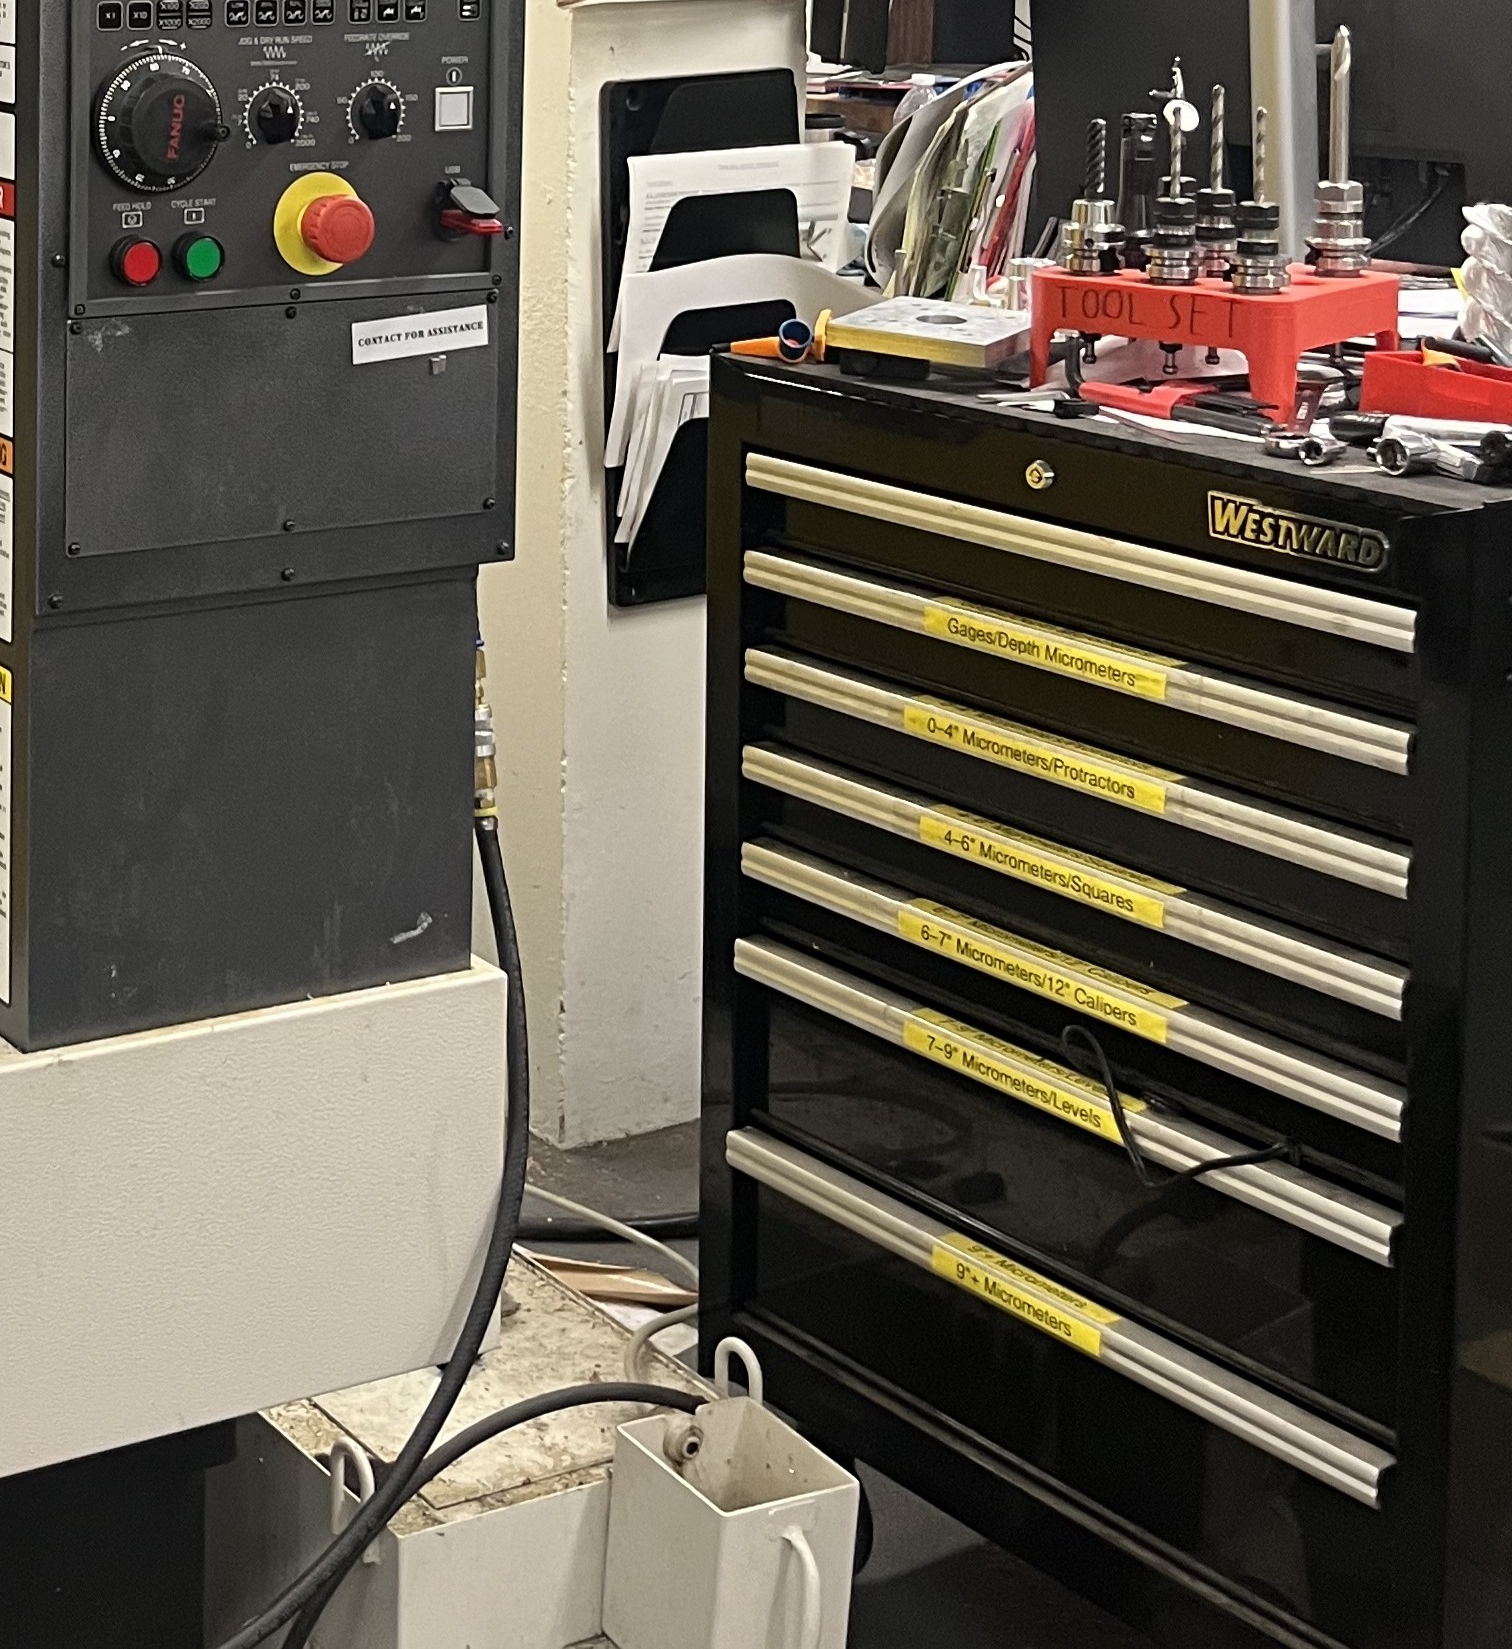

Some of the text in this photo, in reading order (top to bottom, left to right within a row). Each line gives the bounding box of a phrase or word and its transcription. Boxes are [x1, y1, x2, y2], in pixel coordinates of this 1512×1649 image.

[441, 56, 468, 64] POWER
[166, 94, 185, 161] FANUC
[445, 165, 461, 174] USB
[112, 201, 152, 211] FEED HOLD
[171, 198, 217, 209] CYCLE START
[358, 321, 484, 347] CONTACT FOR ASSISTANCE
[1057, 284, 1238, 339] TOOL SET
[947, 617, 1136, 687] Gages/Depth Micrometers
[963, 728, 1135, 799] Micrometers/Protractors
[979, 841, 1134, 912] Micrometers/Squares
[956, 938, 1071, 997] Micrometers/12"
[1074, 987, 1137, 1026] Calipers
[962, 1051, 1101, 1128] Micrometers/Levels
[984, 1276, 1072, 1336] Micrometers
